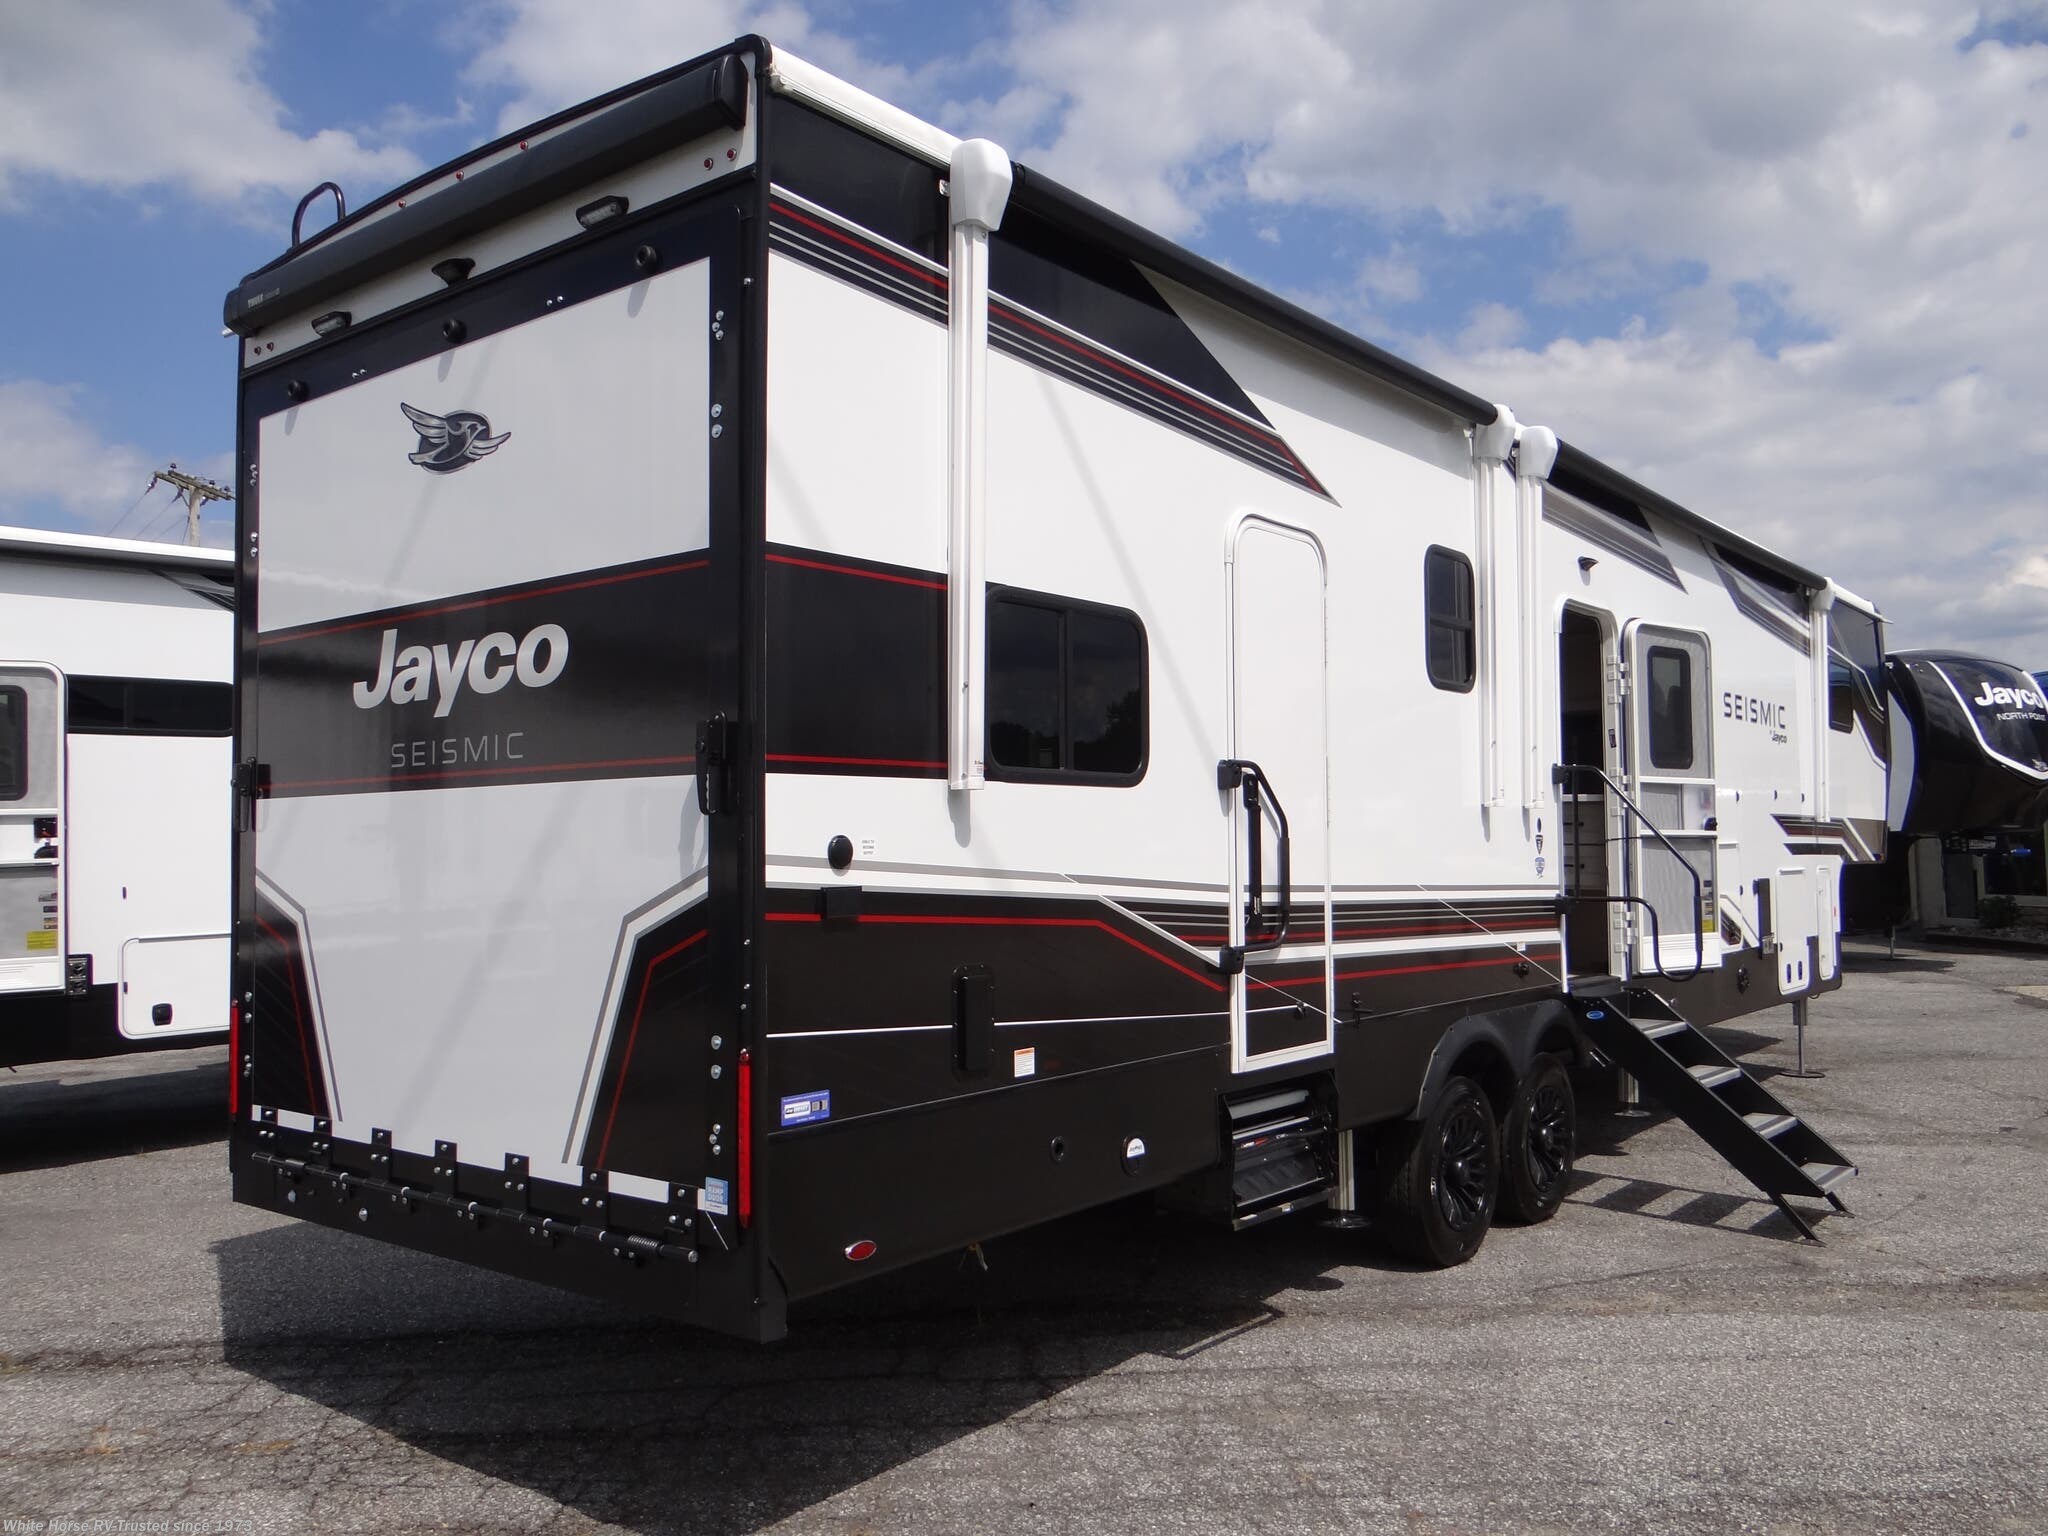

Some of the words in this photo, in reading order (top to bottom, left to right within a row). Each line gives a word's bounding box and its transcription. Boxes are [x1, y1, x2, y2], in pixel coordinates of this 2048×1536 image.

[352, 623, 569, 718] Jayco
[1723, 692, 1786, 729] SEISMIC
[1974, 681, 2045, 709] Jayco
[1996, 711, 2029, 721] NORTH
[391, 732, 524, 768] SEISMIC
